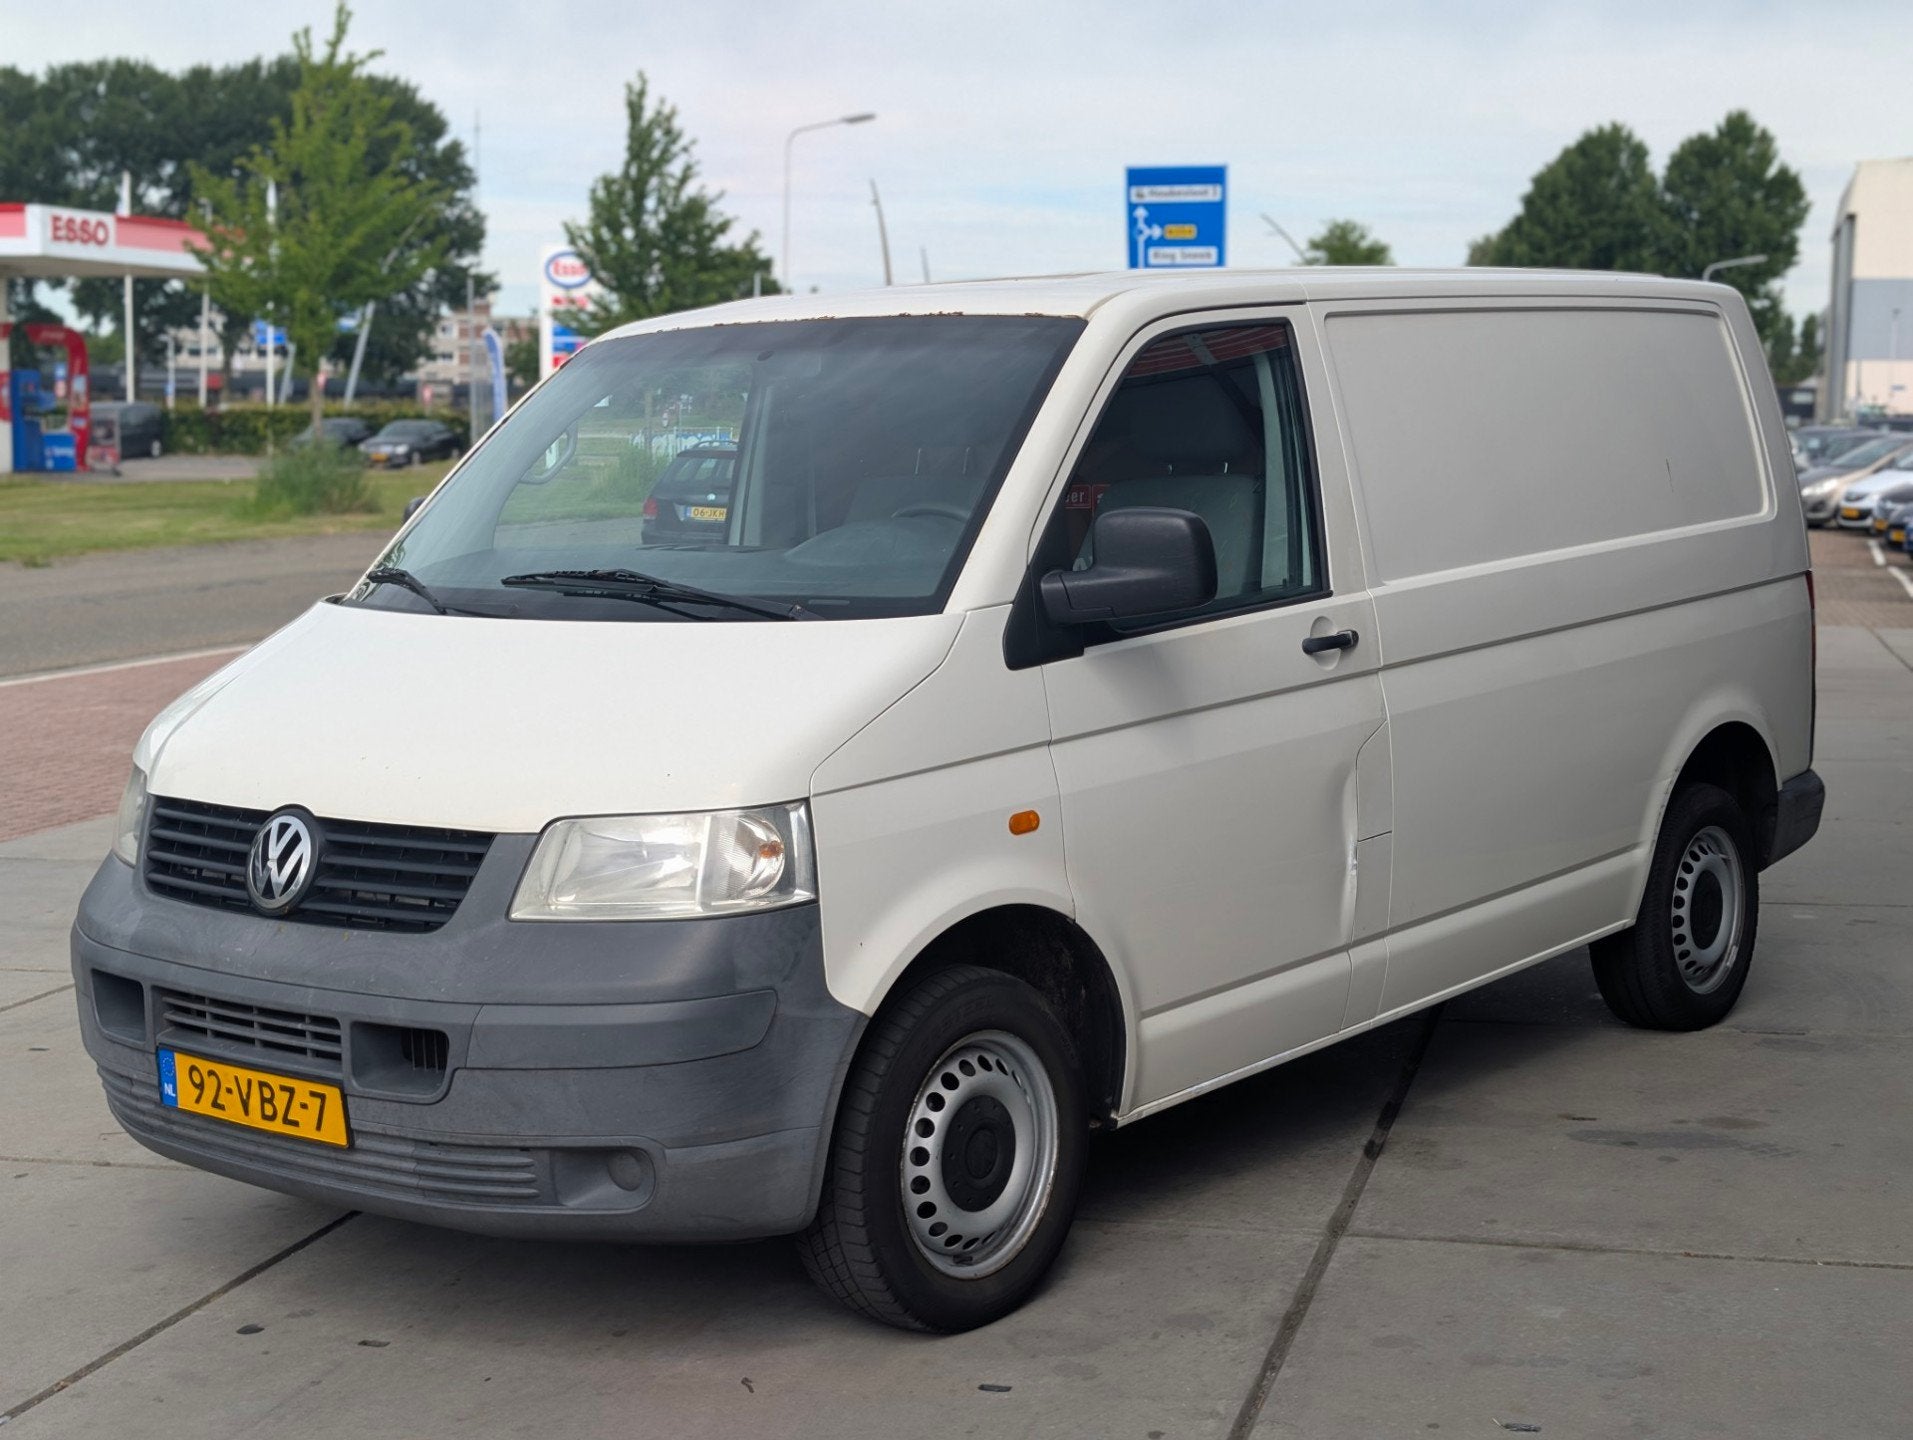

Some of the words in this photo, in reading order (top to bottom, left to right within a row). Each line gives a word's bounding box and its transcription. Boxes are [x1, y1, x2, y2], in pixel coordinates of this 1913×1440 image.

[52, 214, 109, 246] ESSO
[164, 1083, 176, 1098] NL
[188, 1064, 327, 1132] 92-VBZ-7
